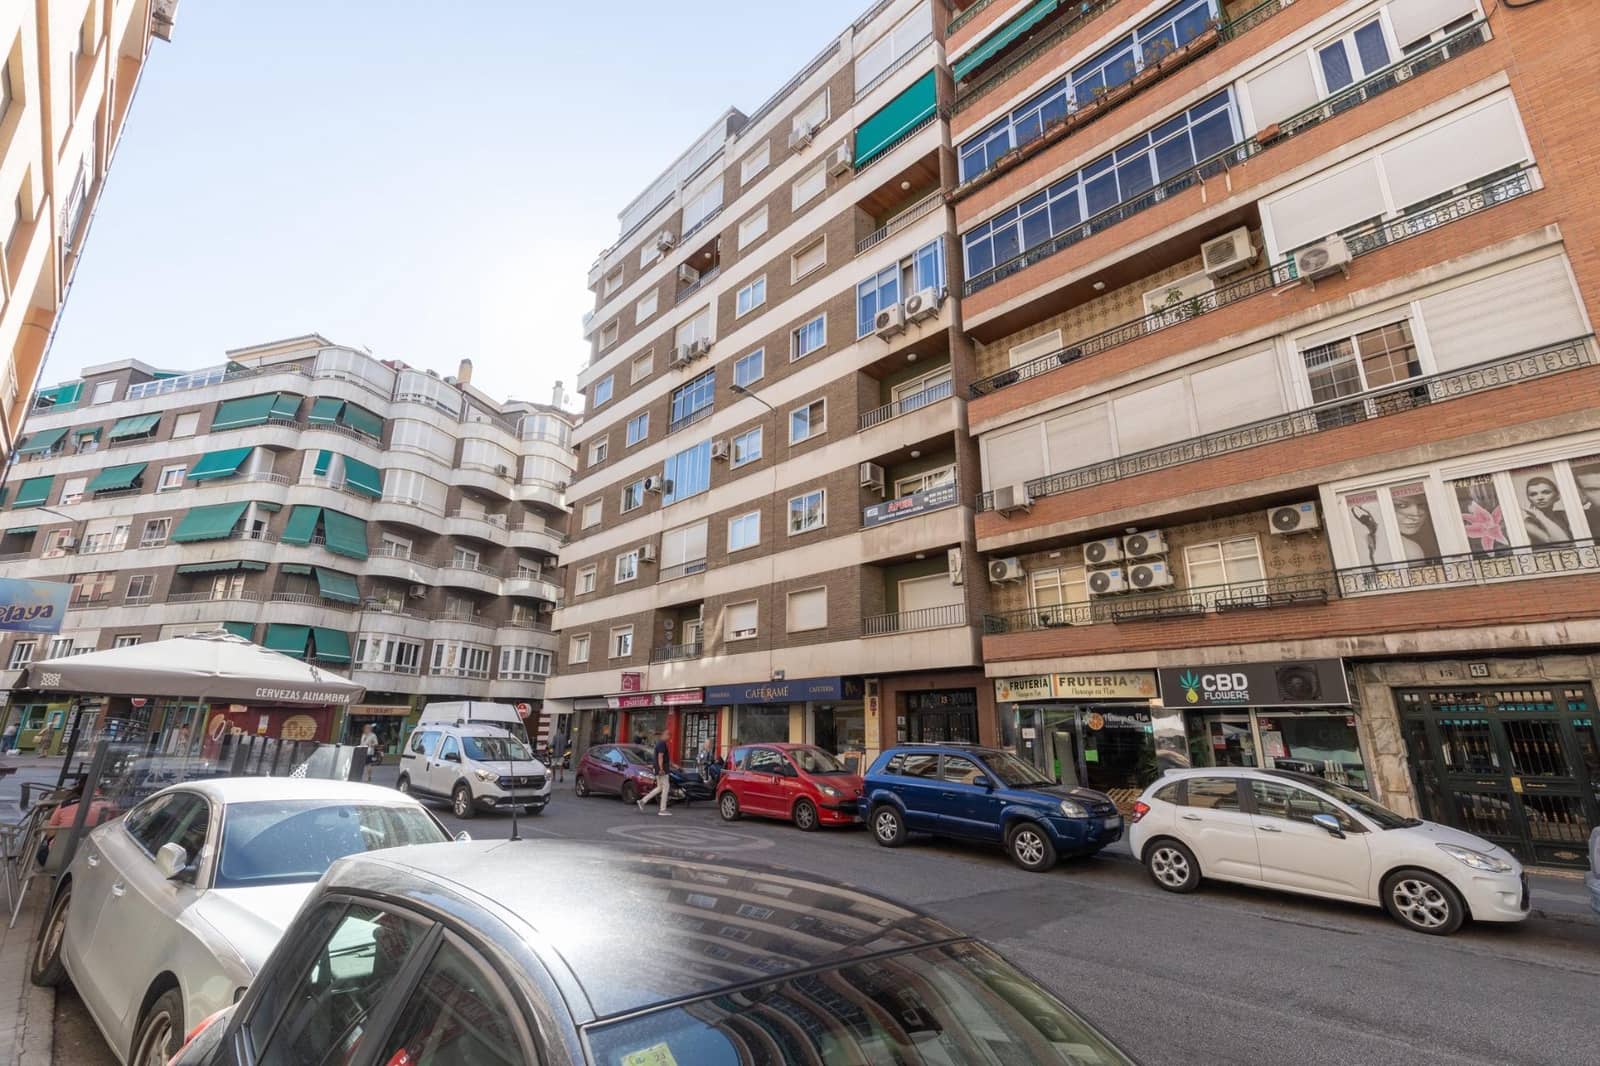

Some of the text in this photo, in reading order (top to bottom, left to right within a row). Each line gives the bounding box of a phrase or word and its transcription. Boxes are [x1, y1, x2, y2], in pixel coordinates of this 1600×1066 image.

[1201, 672, 1249, 692] CBD
[255, 687, 350, 703] CERVEZAS ALHAMBRA
[1204, 691, 1249, 700] FLOWERS
